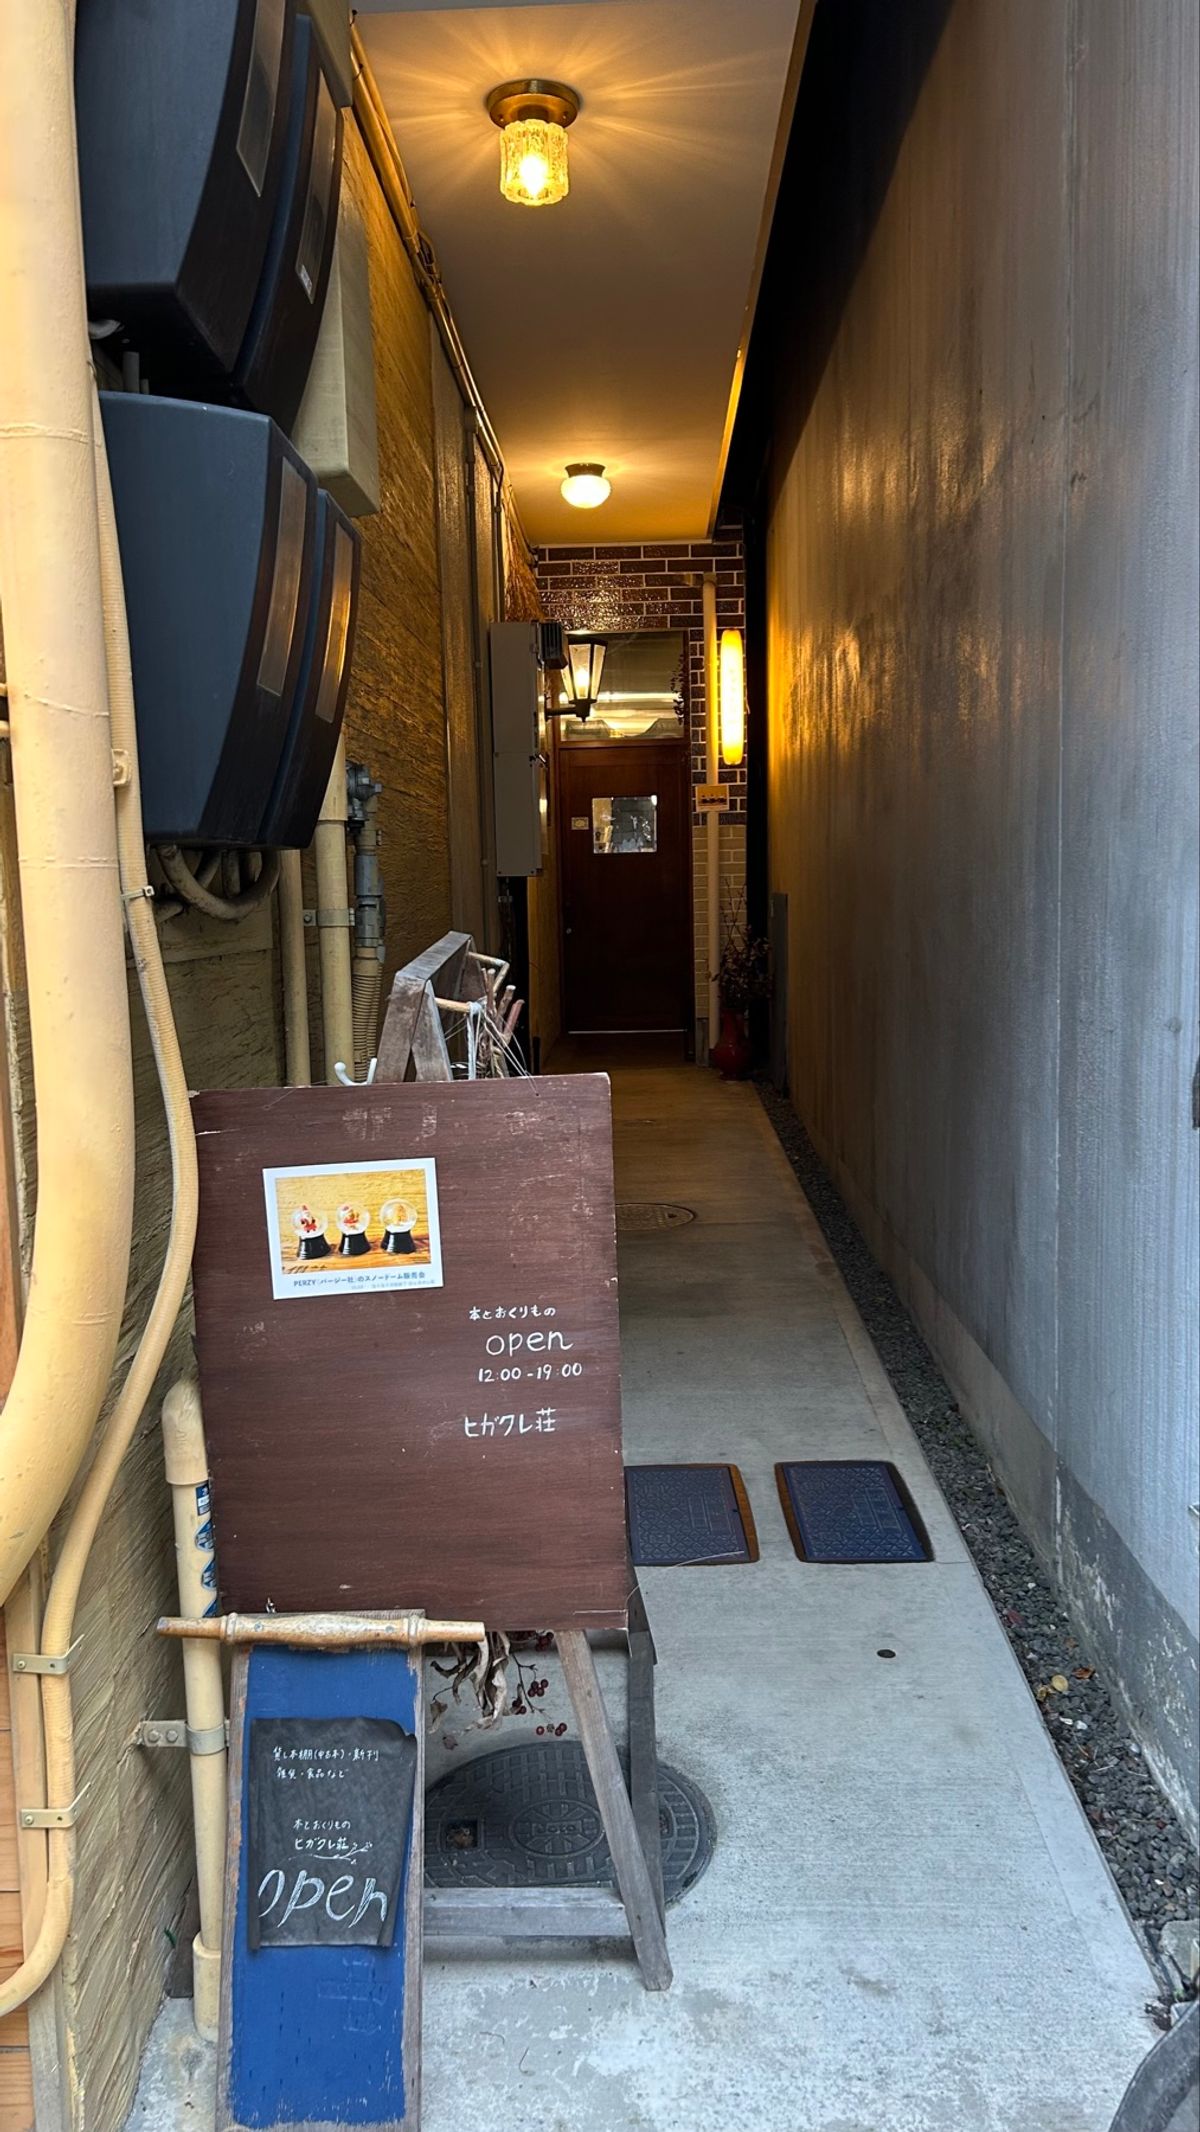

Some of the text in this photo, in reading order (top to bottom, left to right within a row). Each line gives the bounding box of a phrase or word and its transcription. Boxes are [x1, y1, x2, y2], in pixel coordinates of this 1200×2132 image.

[469, 1304, 557, 1321] 本とおくりもの
[485, 1330, 574, 1357] open
[464, 1407, 557, 1438] ヒガクレ荘
[292, 1818, 351, 1831] 本とおくりもの
[294, 1837, 349, 1851] ヒガクレ荘
